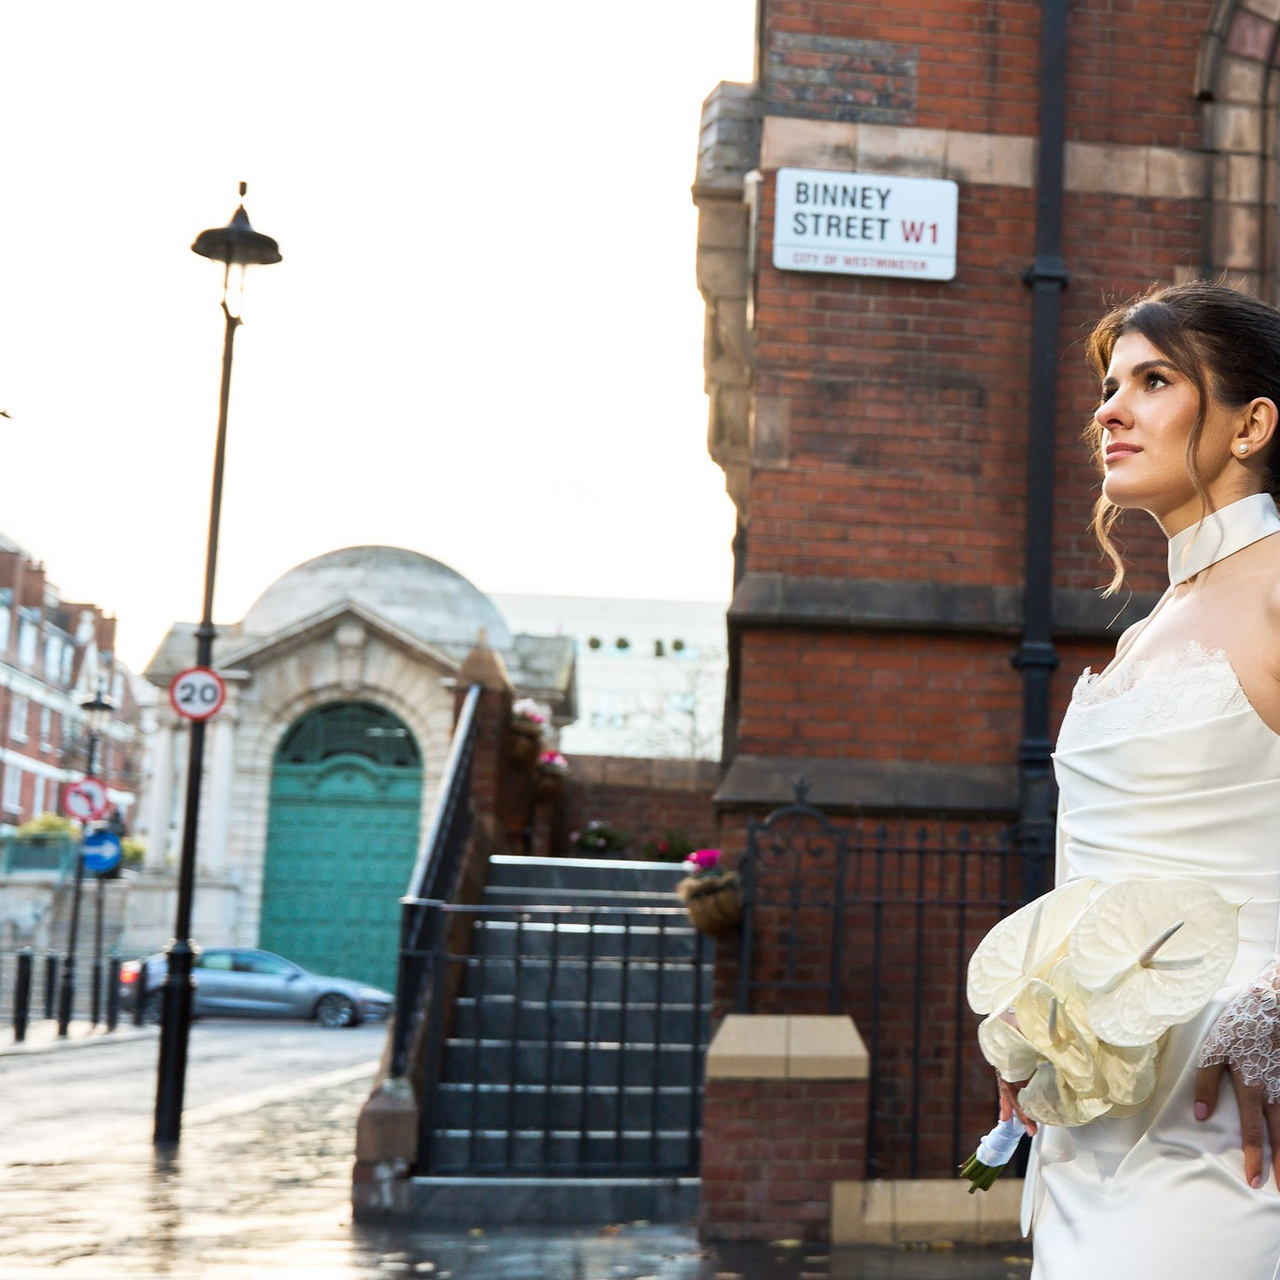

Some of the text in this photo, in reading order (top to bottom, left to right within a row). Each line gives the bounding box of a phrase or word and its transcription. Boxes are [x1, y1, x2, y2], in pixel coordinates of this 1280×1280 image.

[795, 181, 892, 210] BINNEY
[793, 212, 938, 244] STREET W1
[793, 252, 927, 271] CITY OF WESTMINSTER
[180, 682, 219, 705] 20
